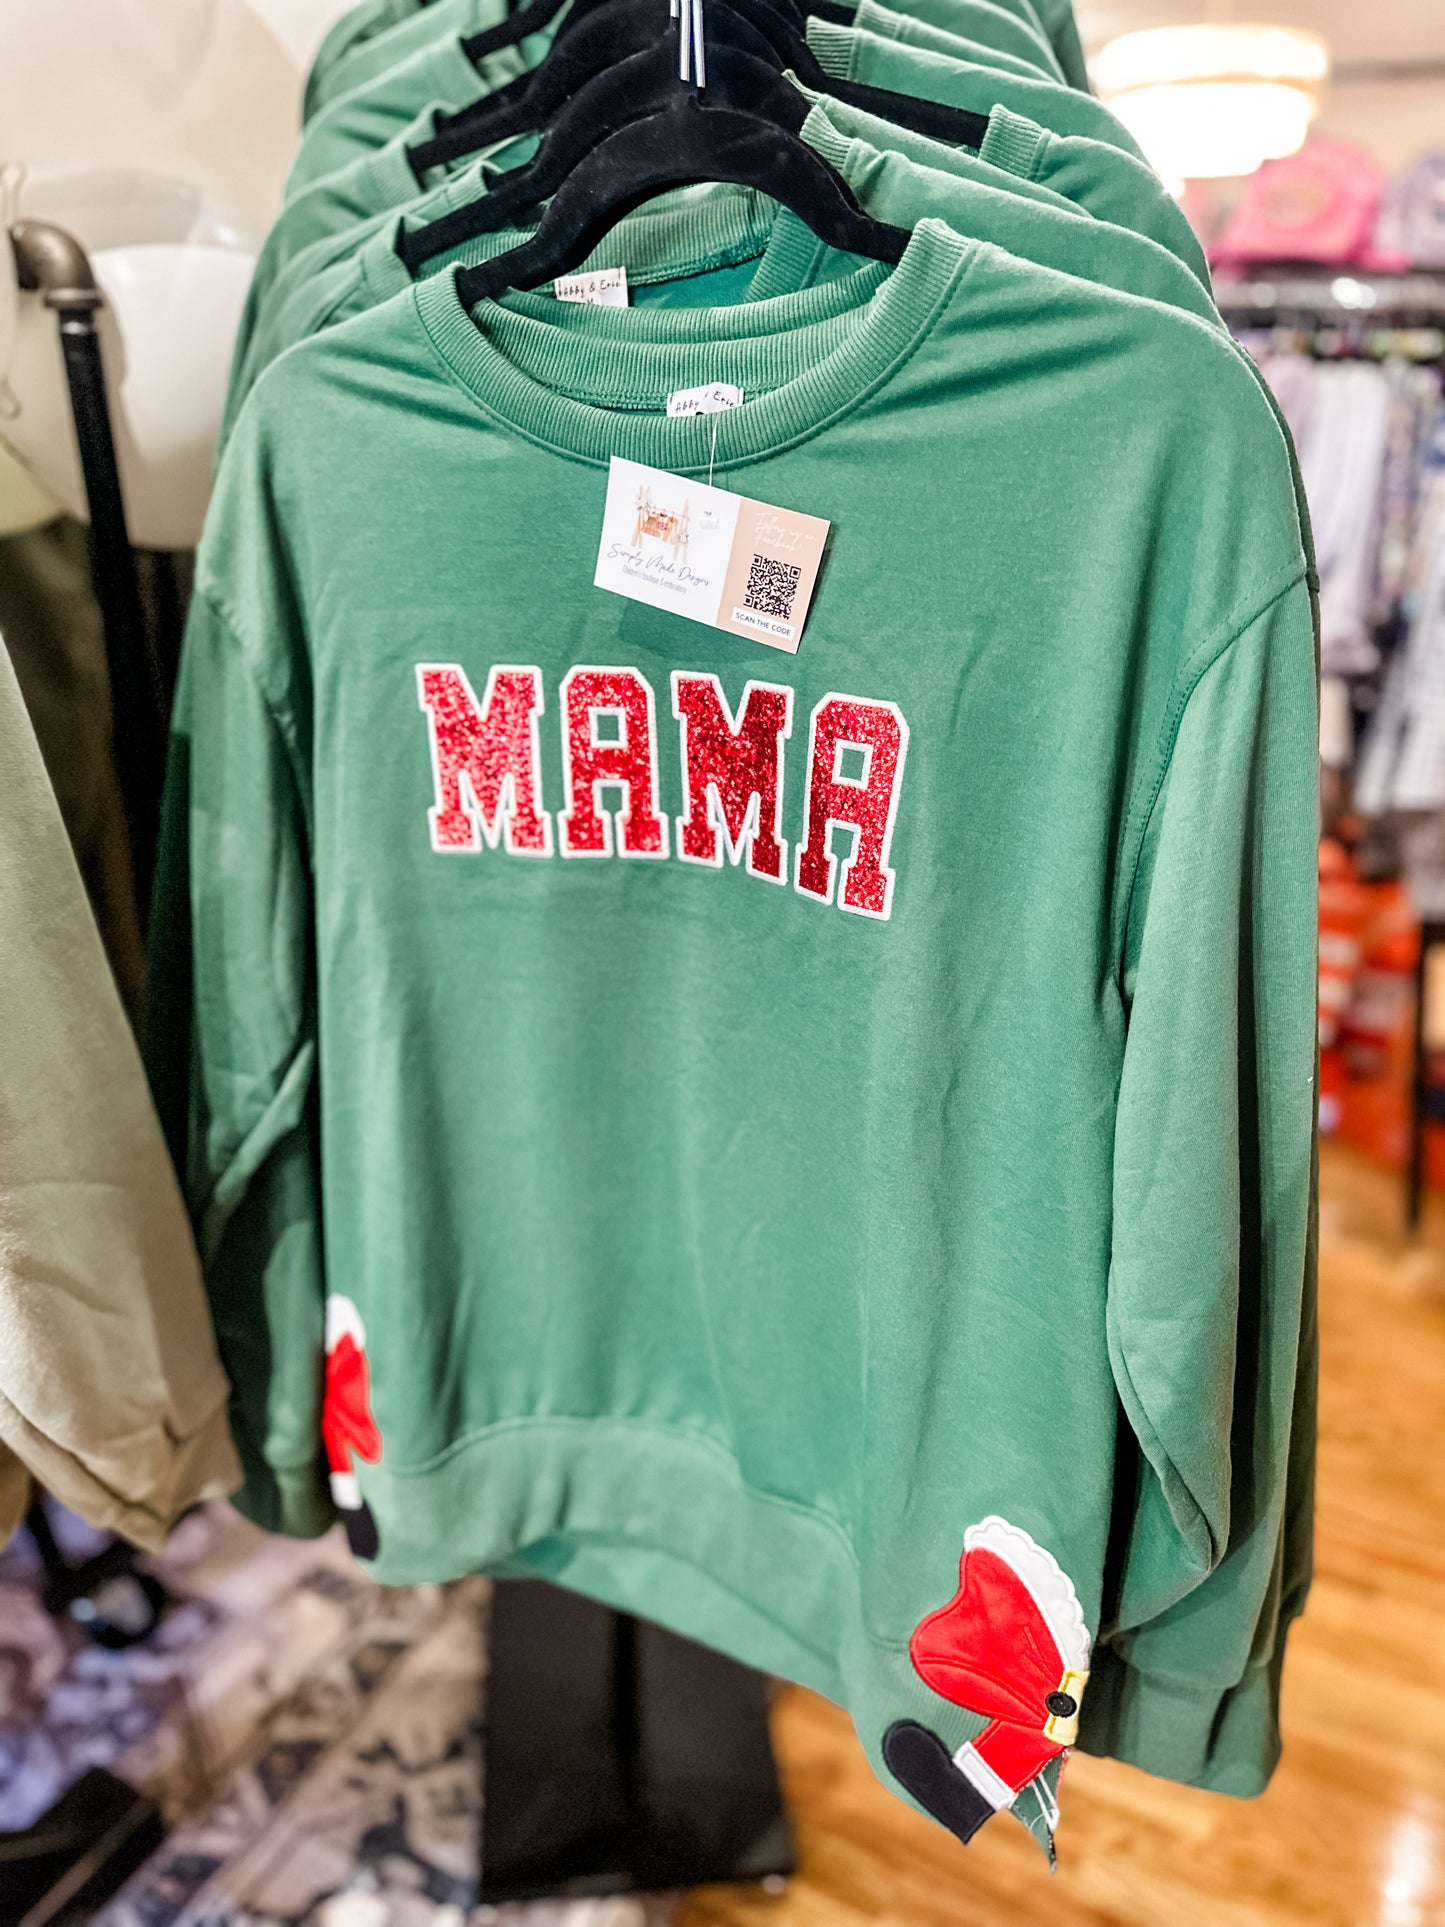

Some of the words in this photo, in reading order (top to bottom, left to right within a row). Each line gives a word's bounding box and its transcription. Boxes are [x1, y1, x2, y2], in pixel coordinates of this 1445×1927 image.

[607, 543, 644, 566] Simply
[645, 555, 676, 573] Made
[678, 566, 710, 586] Designs
[735, 612, 756, 624] SCAN
[757, 619, 770, 629] THE
[771, 624, 791, 636] CODE
[415, 663, 910, 921] MAMA
